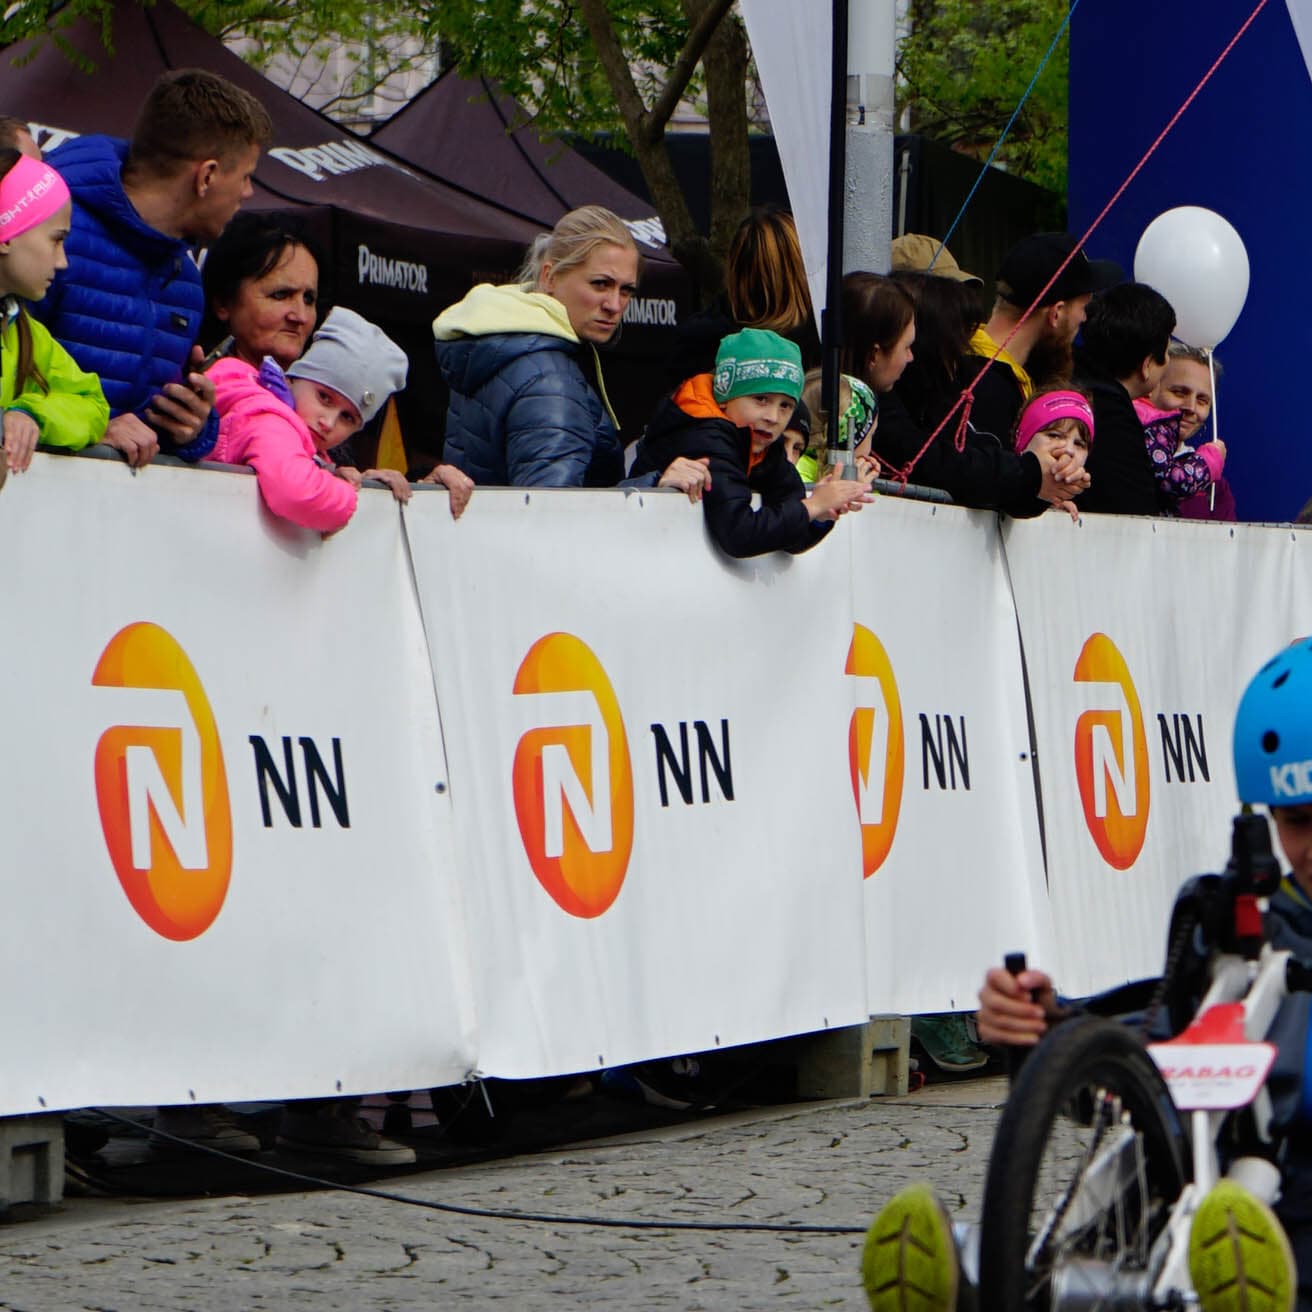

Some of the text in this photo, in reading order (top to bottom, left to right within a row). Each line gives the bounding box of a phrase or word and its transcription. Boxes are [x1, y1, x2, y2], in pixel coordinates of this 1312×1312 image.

[357, 243, 429, 294] PRIMATOR
[623, 296, 678, 326] RIMATOR
[248, 734, 351, 829] NN
[650, 718, 735, 808] NN
[918, 712, 971, 791] NN
[1156, 712, 1211, 784] NN
[1160, 1065, 1256, 1080] RABAG
